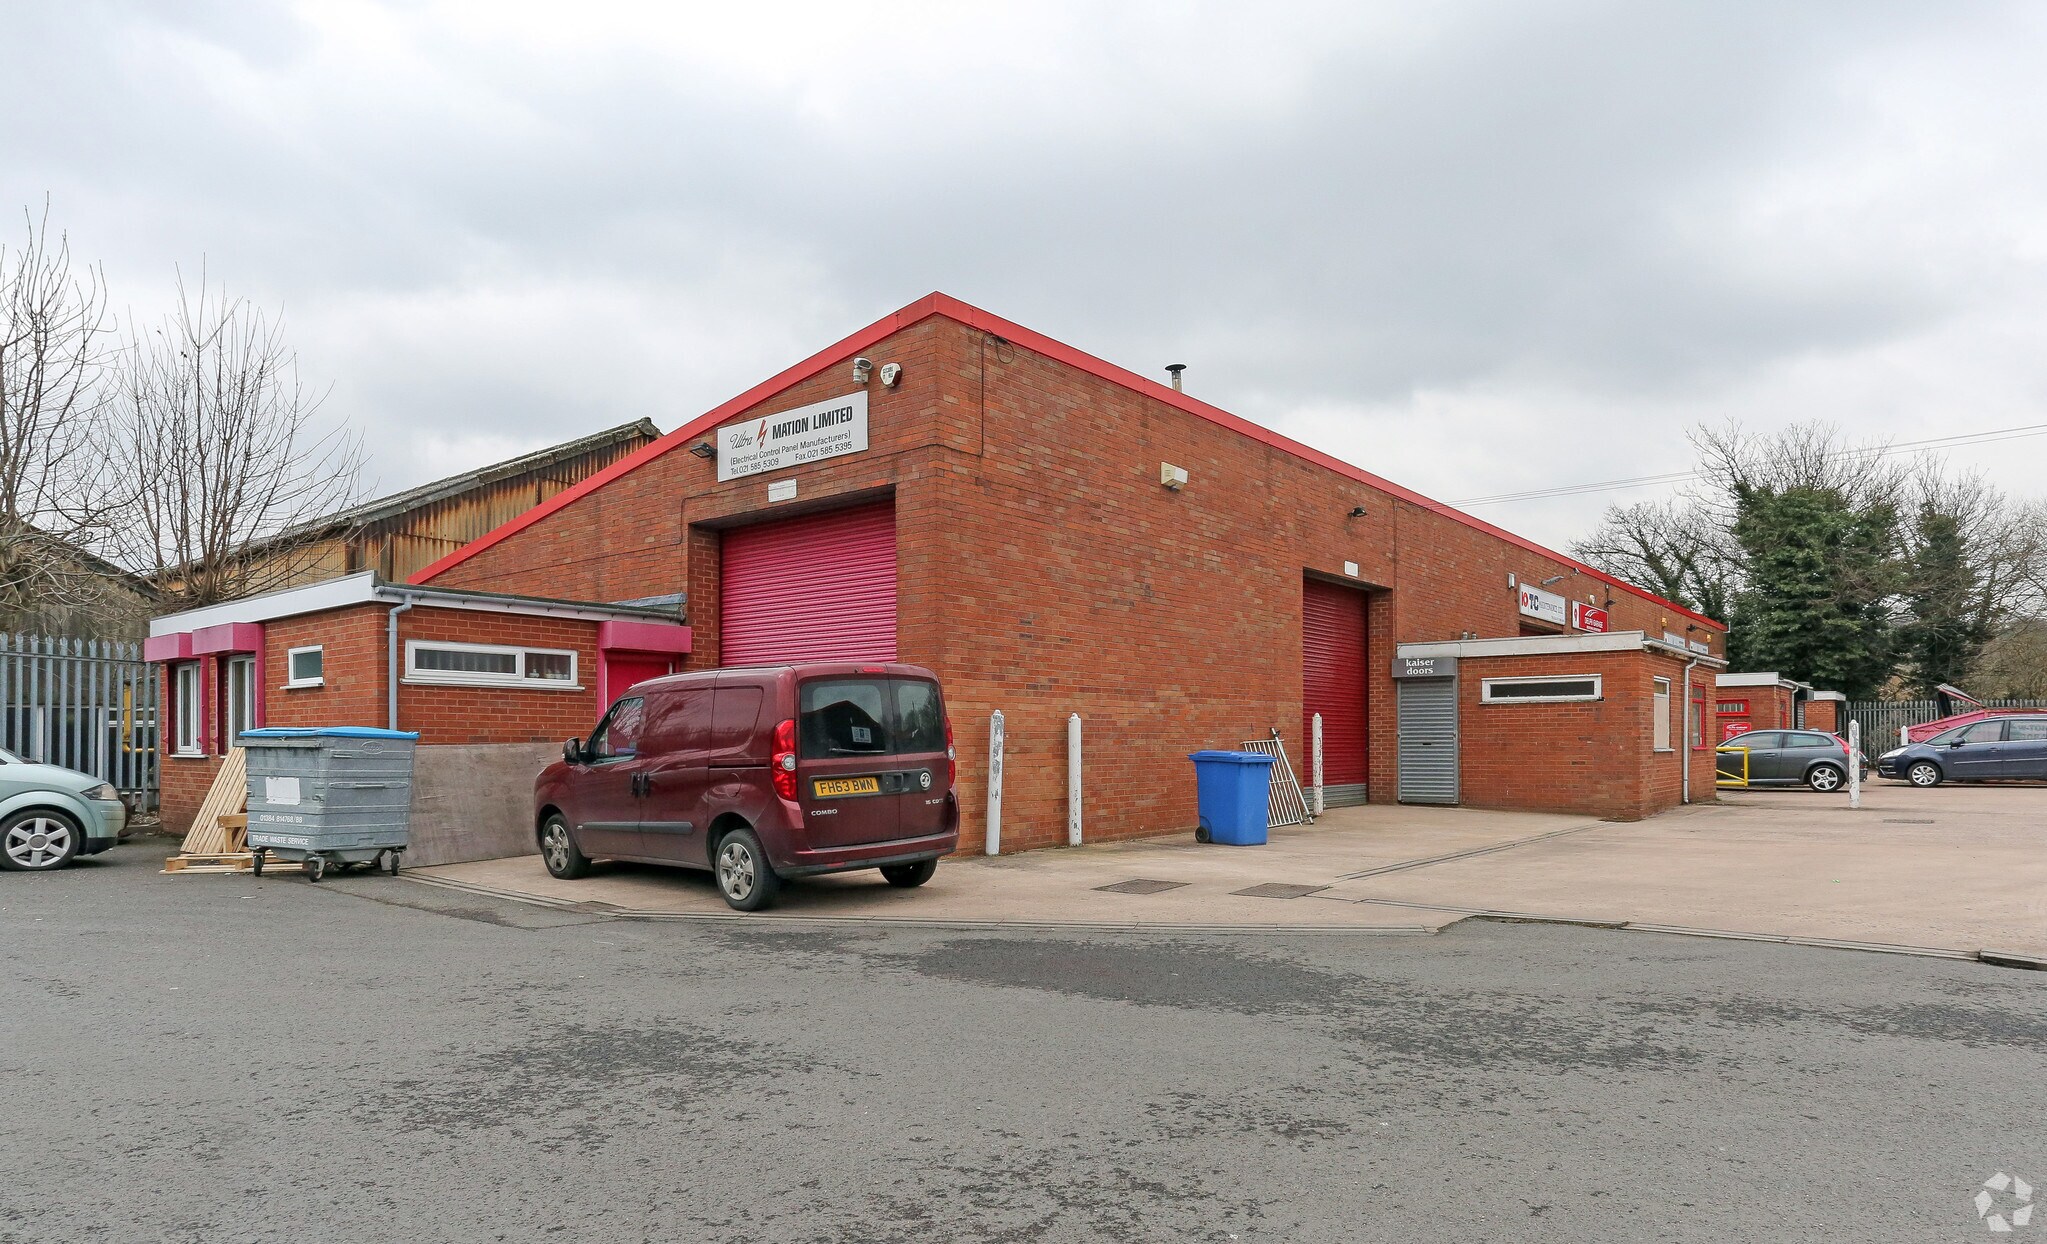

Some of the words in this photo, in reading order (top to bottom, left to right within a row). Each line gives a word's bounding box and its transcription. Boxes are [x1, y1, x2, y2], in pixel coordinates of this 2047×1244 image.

[730, 430, 753, 449] Ultra
[772, 417, 809, 440] MATION
[813, 405, 853, 430] LIMITED
[730, 453, 758, 466] (Electrical
[759, 447, 780, 459] Control
[782, 443, 799, 453] Panel
[800, 429, 851, 449] Manufacturers)
[820, 445, 833, 456] 585
[835, 441, 852, 452] 5395
[750, 461, 761, 471] 585
[763, 457, 779, 468] 5309
[1529, 593, 1539, 611] TC
[1405, 659, 1434, 667] kaiser
[1406, 667, 1434, 675] doors
[819, 781, 850, 794] FH63
[853, 779, 874, 791] BWN
[260, 814, 275, 822] 01384
[811, 808, 838, 816] COMBO
[252, 834, 269, 843] TRADE
[270, 836, 287, 844] WASTE
[288, 837, 309, 845] SERVICE
